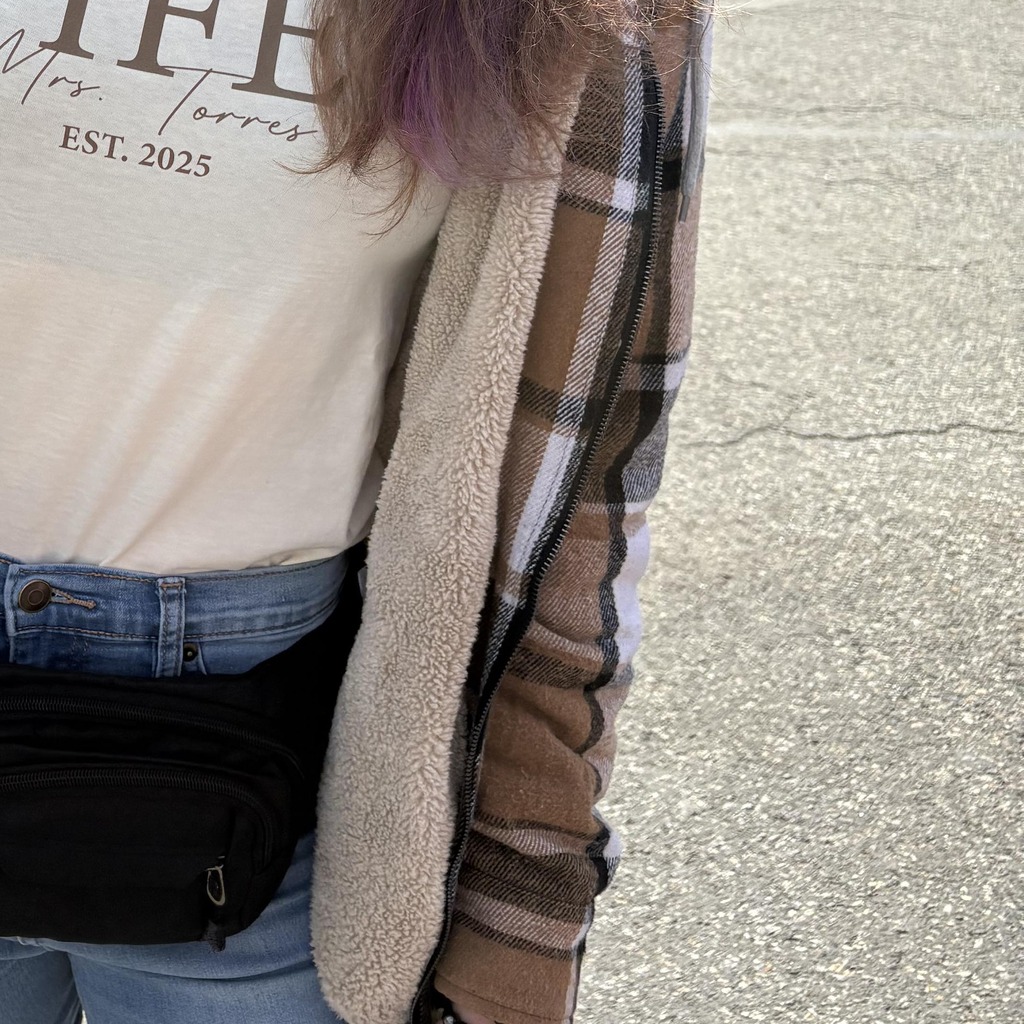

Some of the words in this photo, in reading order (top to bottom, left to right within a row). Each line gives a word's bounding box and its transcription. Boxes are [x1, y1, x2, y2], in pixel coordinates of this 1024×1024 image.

[158, 65, 318, 142] Torres
[59, 124, 128, 162] EST.
[138, 142, 212, 177] 2025
